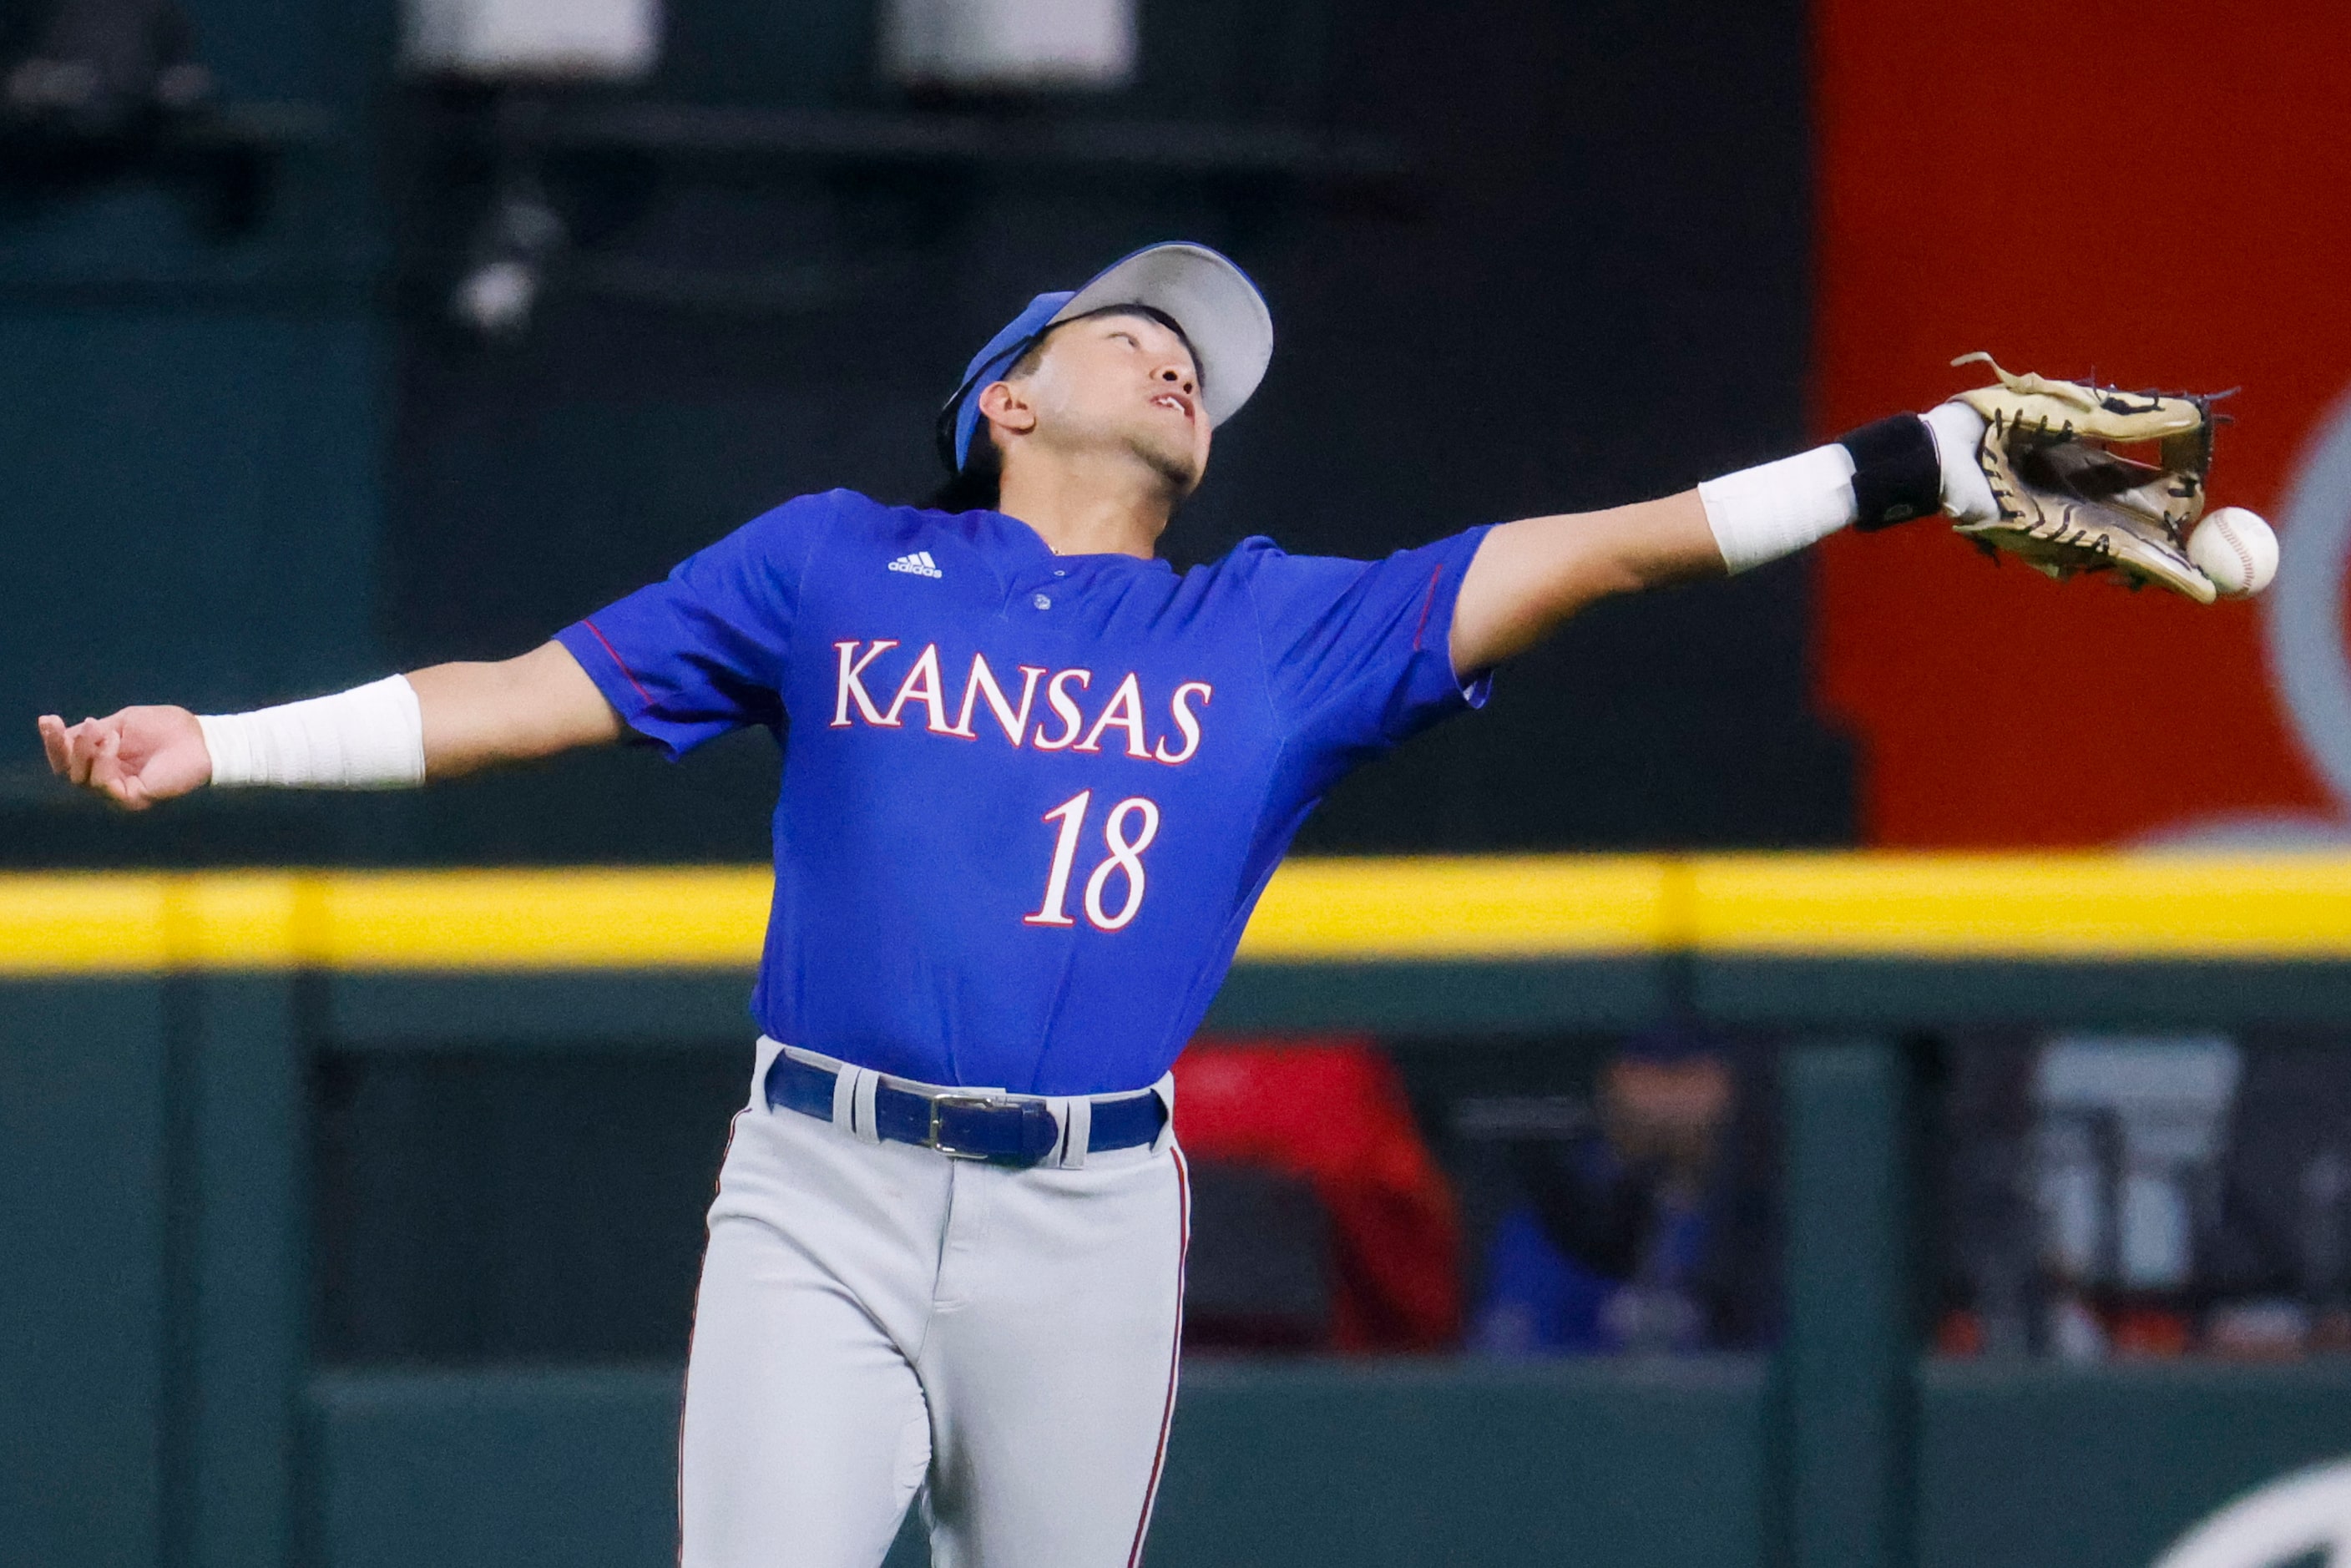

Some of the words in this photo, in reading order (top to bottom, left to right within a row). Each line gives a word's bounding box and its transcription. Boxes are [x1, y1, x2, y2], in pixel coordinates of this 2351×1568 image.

[888, 560, 943, 579] adidas
[829, 639, 1213, 765] KANSAS
[1023, 788, 1160, 932] 18
